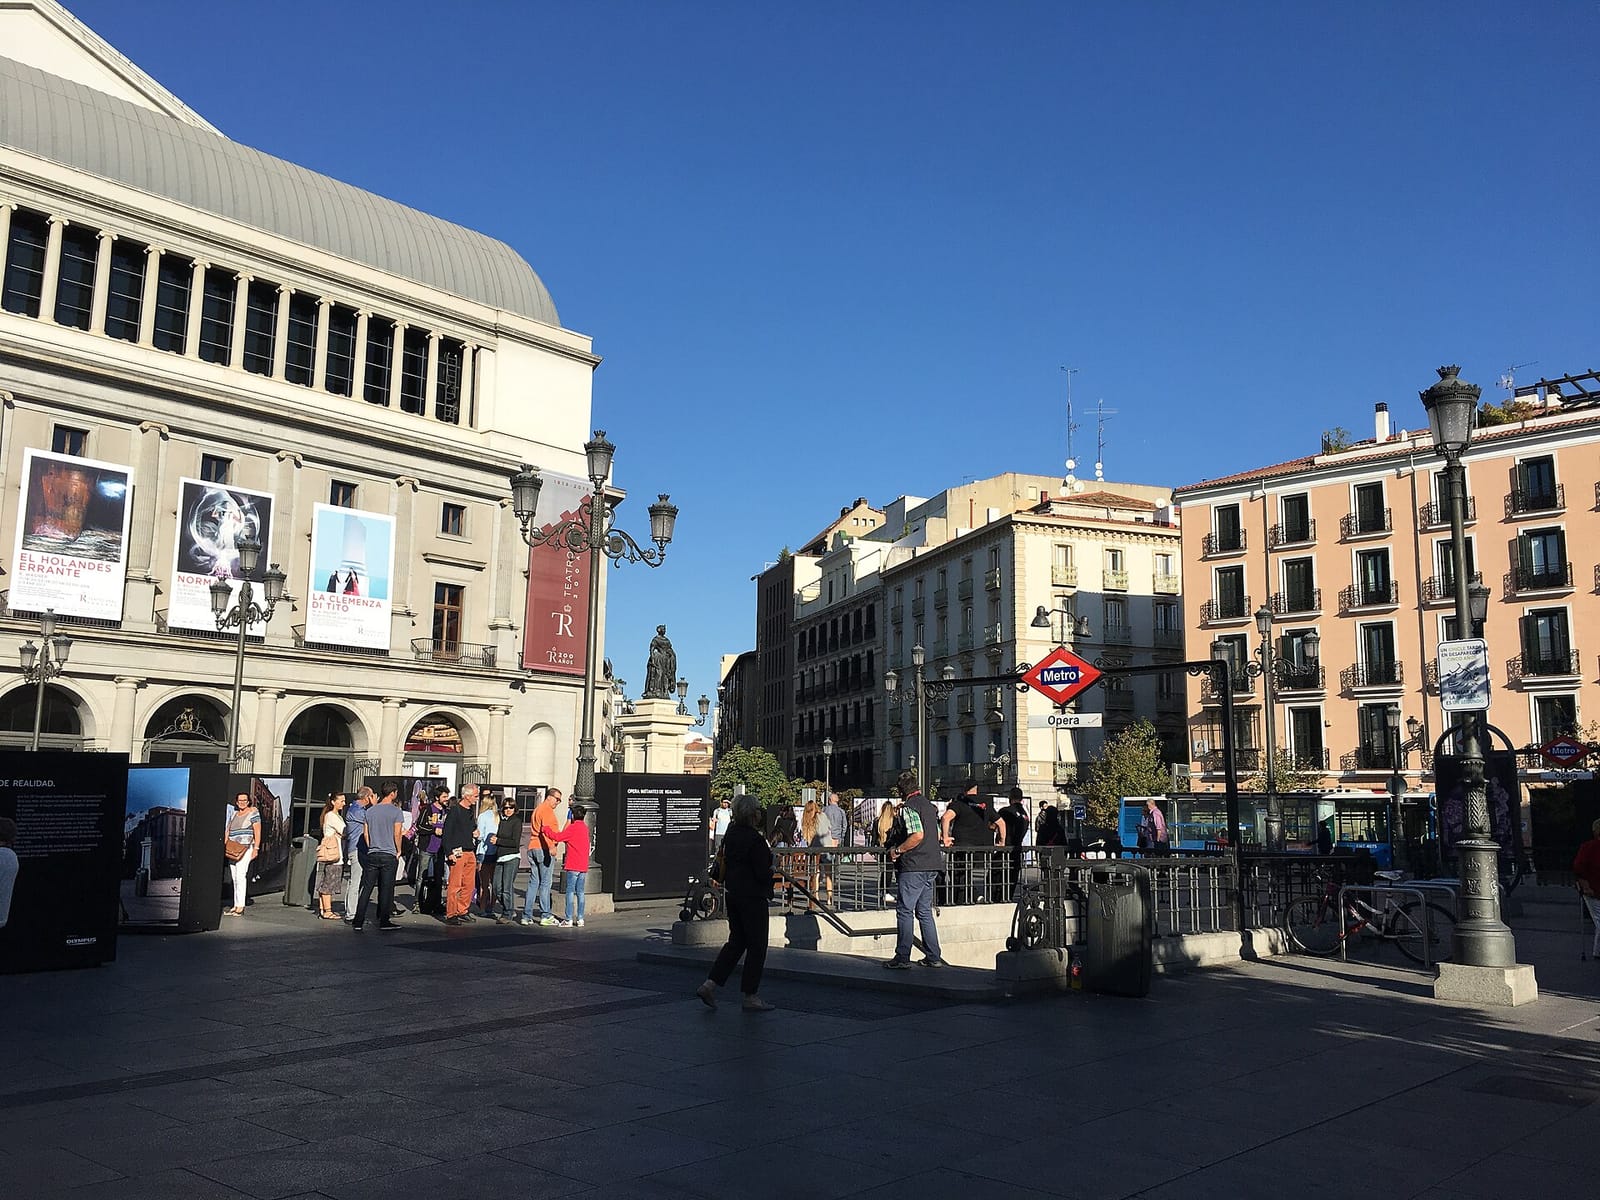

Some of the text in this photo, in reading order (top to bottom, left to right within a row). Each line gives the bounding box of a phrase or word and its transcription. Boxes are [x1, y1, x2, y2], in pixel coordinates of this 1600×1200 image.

[20, 553, 35, 563] EL
[19, 562, 81, 578] ERRANTE
[564, 551, 575, 597] TEATRO
[312, 593, 382, 608] LA CLEMENZA
[312, 601, 349, 612] DI TITO
[1044, 670, 1076, 682] Metro
[1047, 715, 1080, 727] Opera
[1555, 772, 1578, 780] Opera
[12, 780, 56, 788] REALIDAD.
